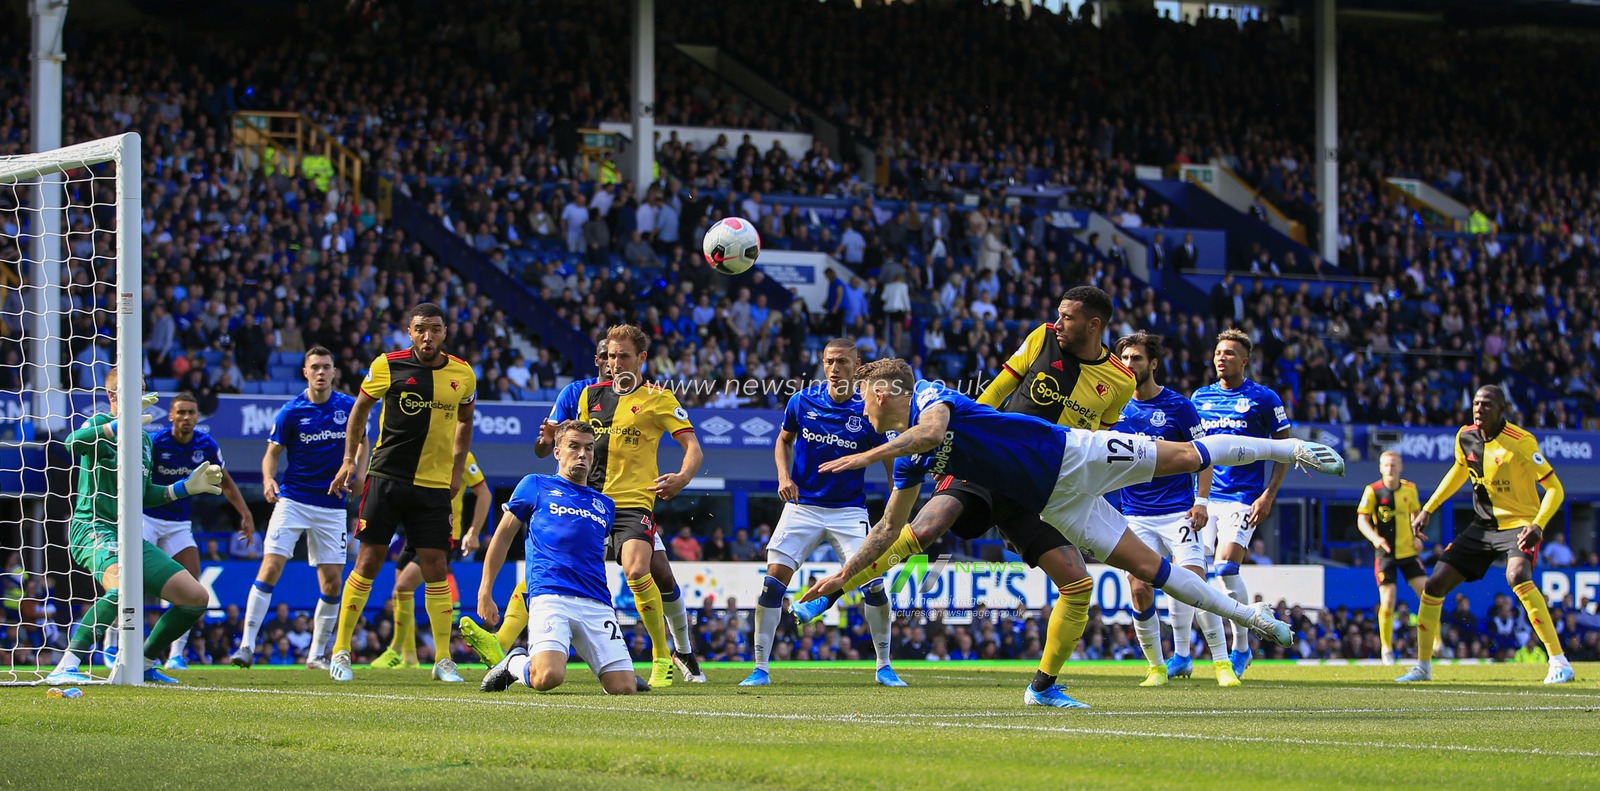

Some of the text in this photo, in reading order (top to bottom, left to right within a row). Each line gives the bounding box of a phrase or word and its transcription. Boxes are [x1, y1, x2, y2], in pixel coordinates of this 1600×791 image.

[1200, 417, 1247, 431] SportPesa
[802, 428, 857, 449] SportPesa
[1107, 439, 1135, 464] 12
[549, 503, 607, 528] SportPesa
